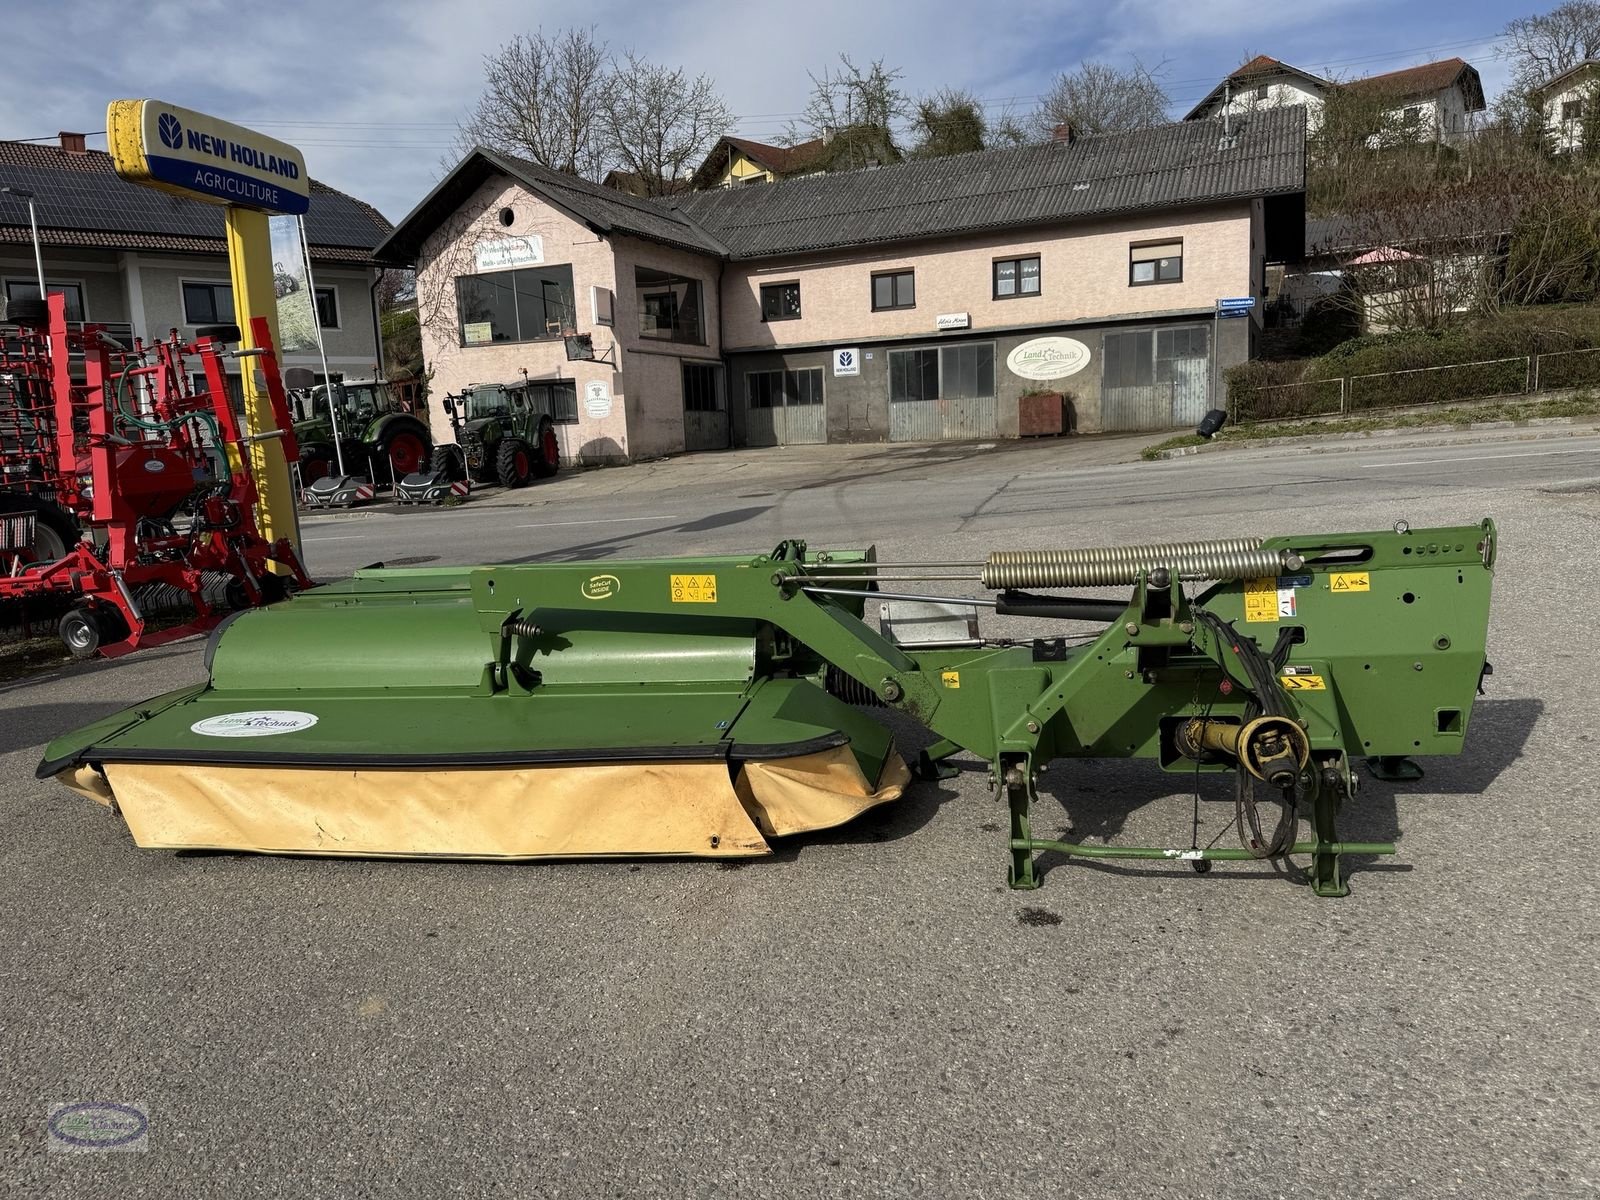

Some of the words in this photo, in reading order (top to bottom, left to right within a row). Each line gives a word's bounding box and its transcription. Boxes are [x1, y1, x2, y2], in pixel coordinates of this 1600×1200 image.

[187, 128, 227, 159] NEW
[230, 142, 299, 180] HOLLAND
[194, 169, 278, 204] AGRICULTURE
[1023, 350, 1042, 359] Land
[1048, 351, 1077, 360] Technik
[590, 580, 611, 588] SafeCut
[591, 586, 609, 594] INSIDE
[254, 719, 299, 727] Technik
